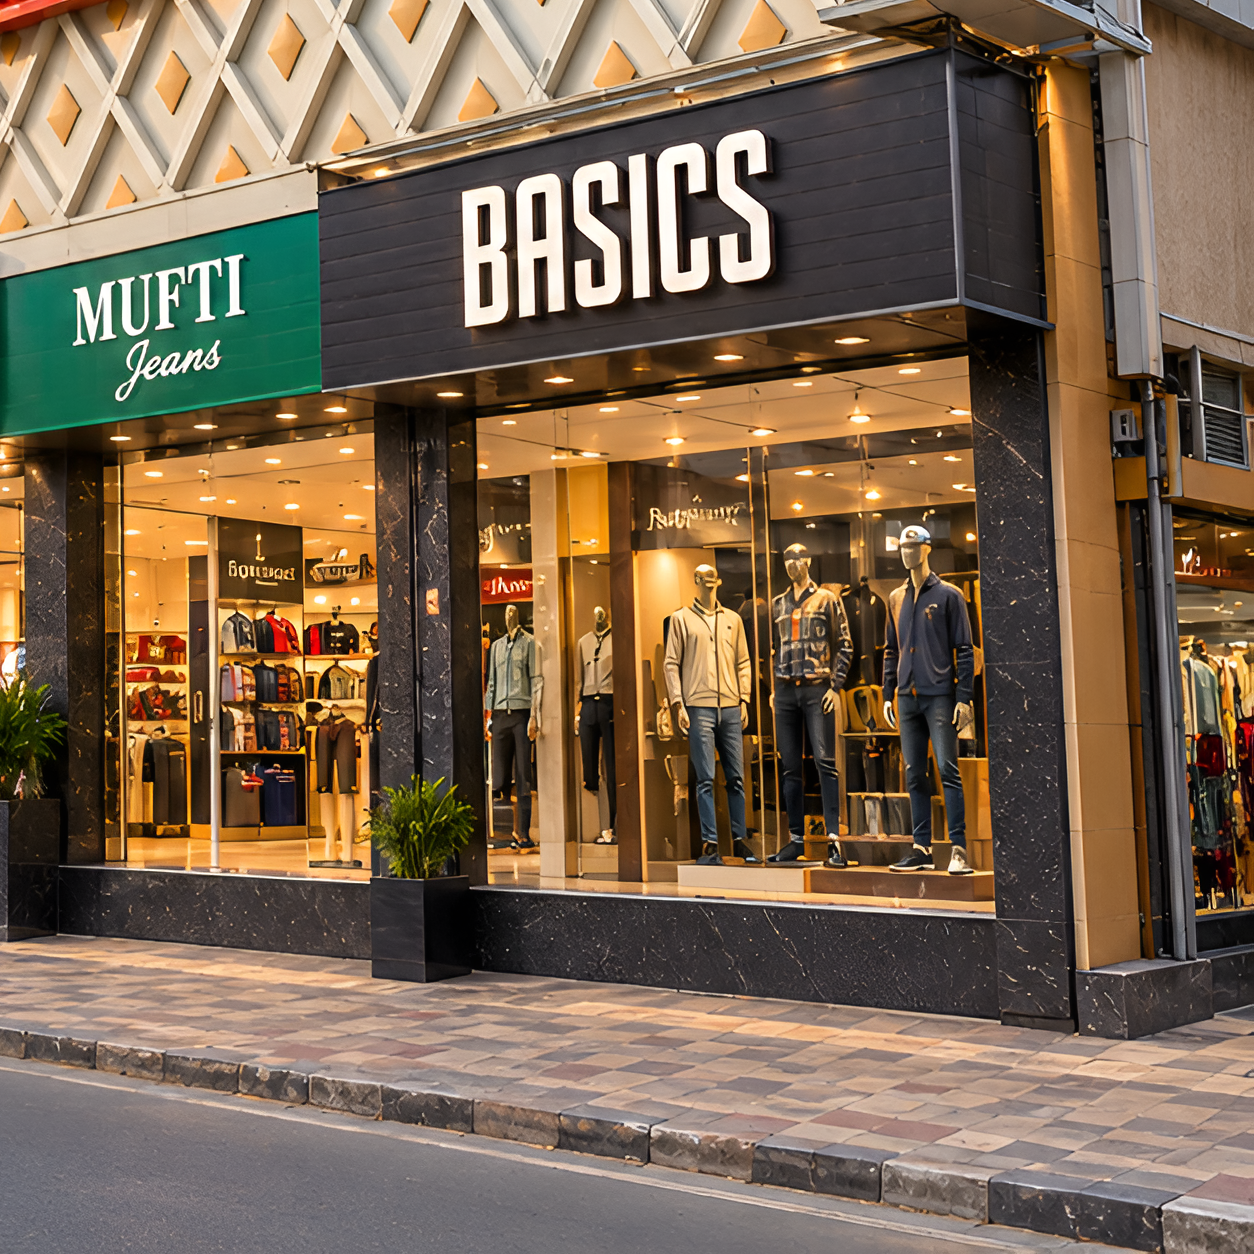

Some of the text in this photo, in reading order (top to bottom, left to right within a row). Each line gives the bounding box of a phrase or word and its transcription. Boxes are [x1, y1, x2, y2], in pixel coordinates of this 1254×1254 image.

[462, 129, 774, 328] BASICS
[72, 253, 247, 347] MUFTI
[114, 339, 221, 402] Jeans
